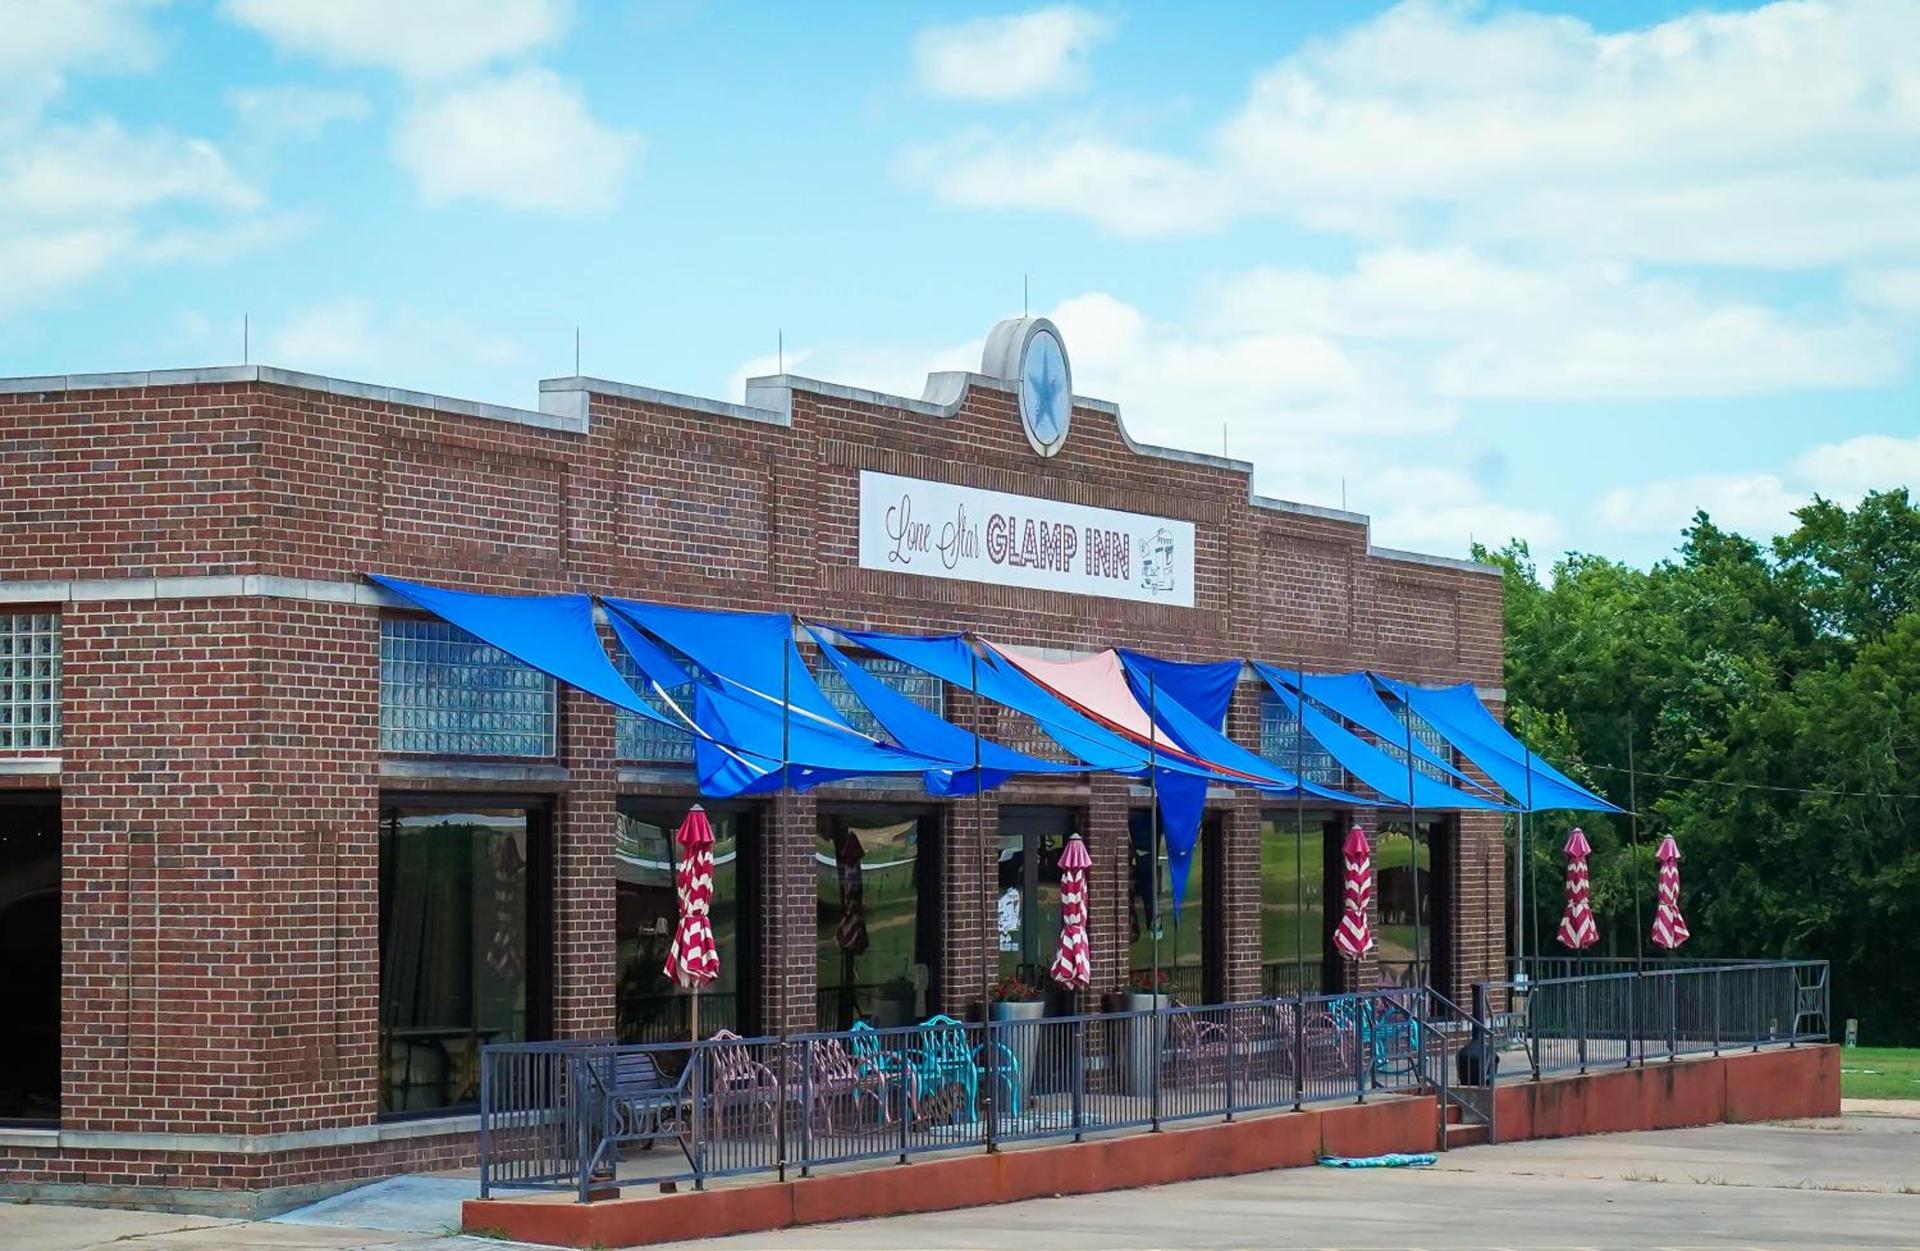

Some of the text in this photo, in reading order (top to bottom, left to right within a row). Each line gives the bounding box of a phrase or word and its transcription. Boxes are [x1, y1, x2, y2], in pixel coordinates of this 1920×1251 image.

[886, 494, 1129, 580] Lone Star GLAMP INN
